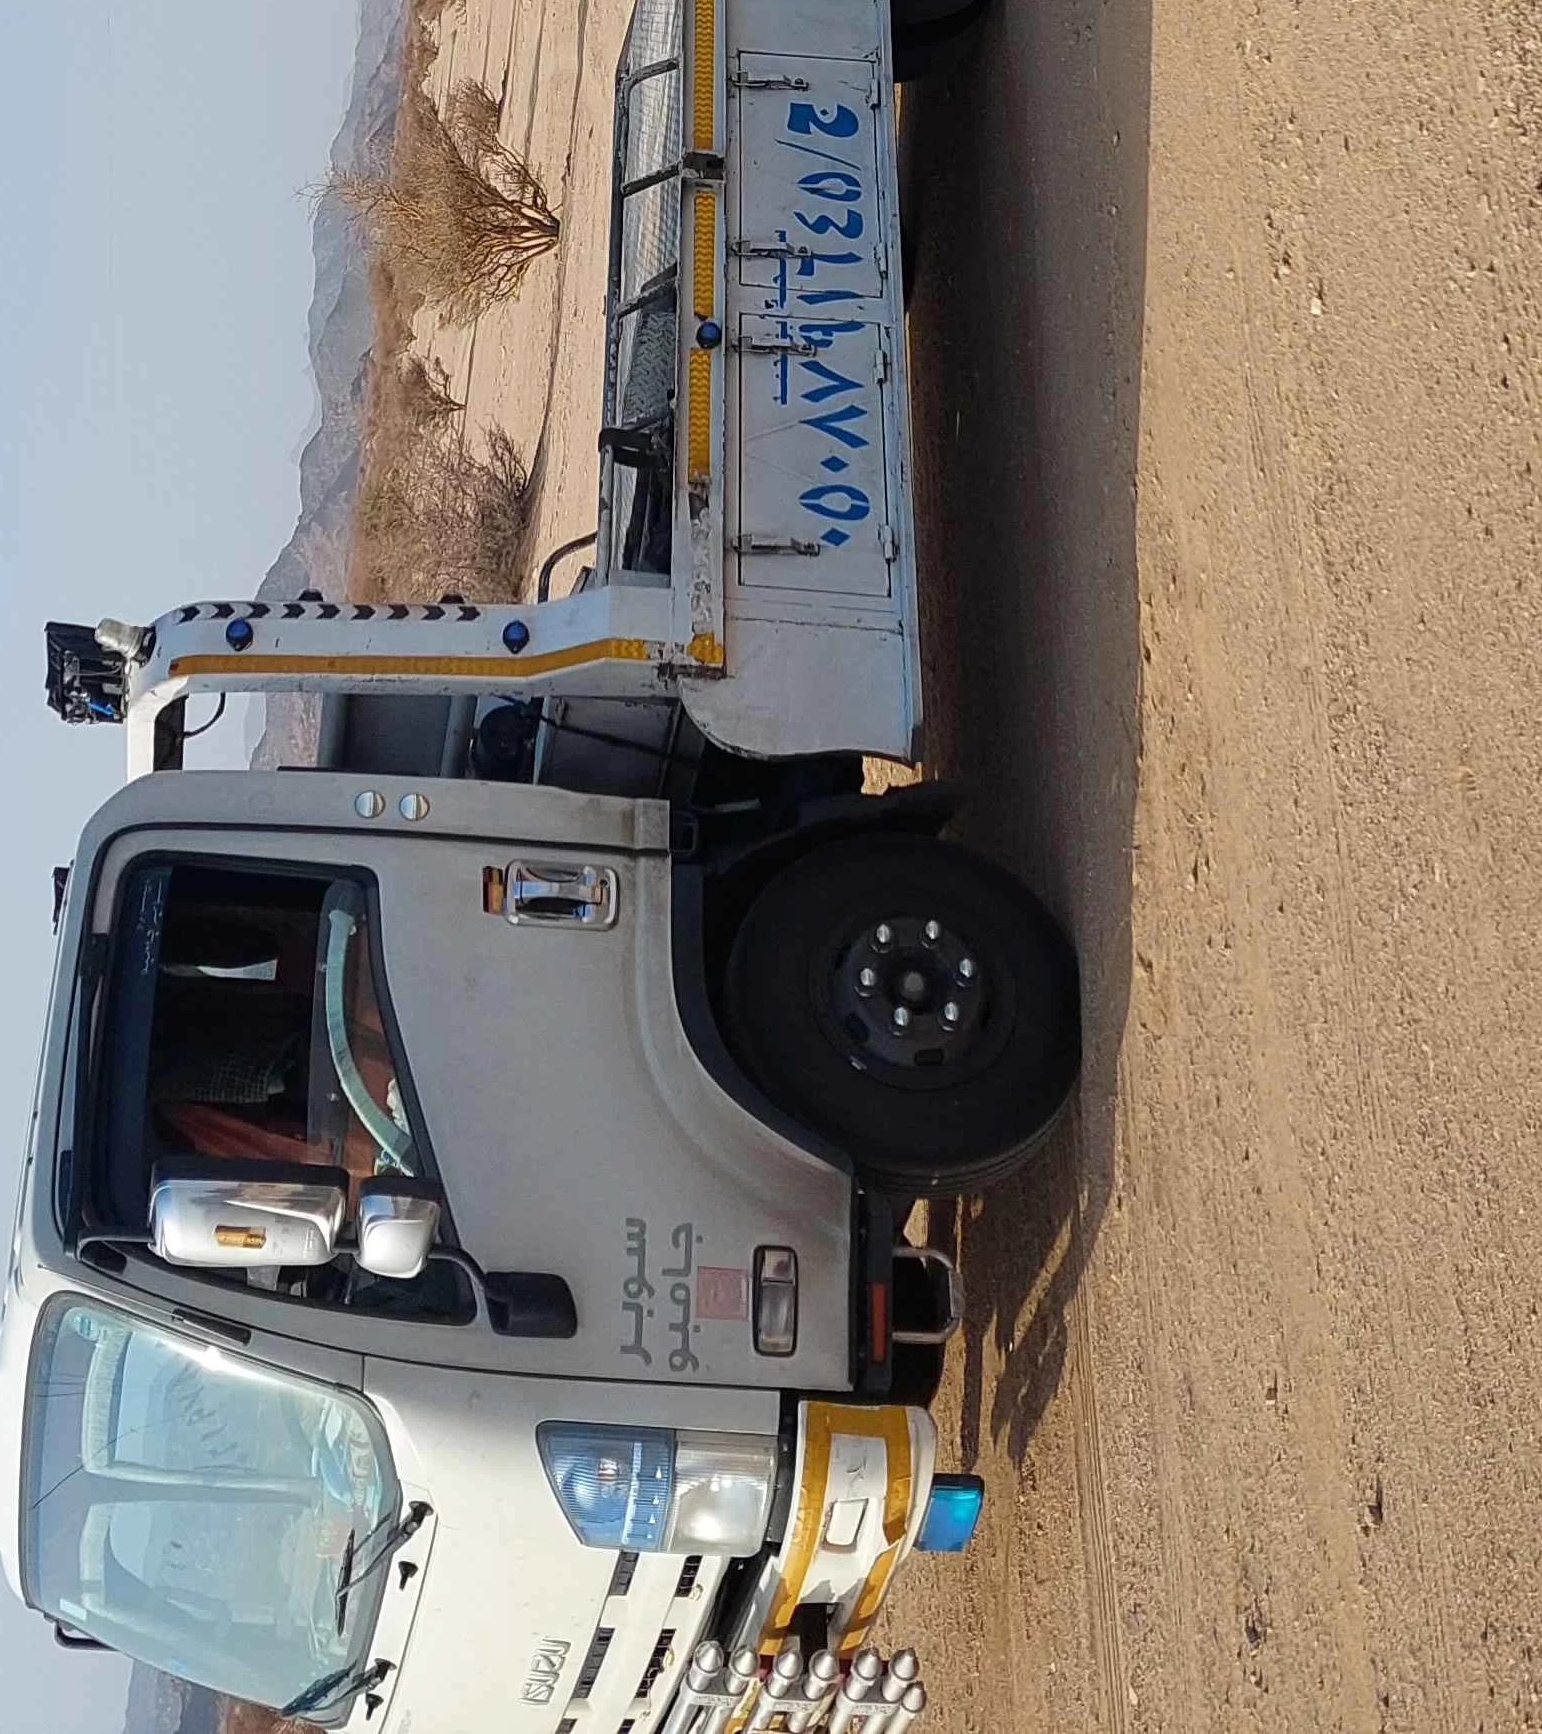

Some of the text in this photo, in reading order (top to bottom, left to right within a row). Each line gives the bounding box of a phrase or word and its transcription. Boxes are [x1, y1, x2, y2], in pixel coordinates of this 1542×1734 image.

[619, 1217, 655, 1367] سوبر
[662, 1222, 702, 1373] جامبو
[517, 1637, 571, 1706] ISUZU
